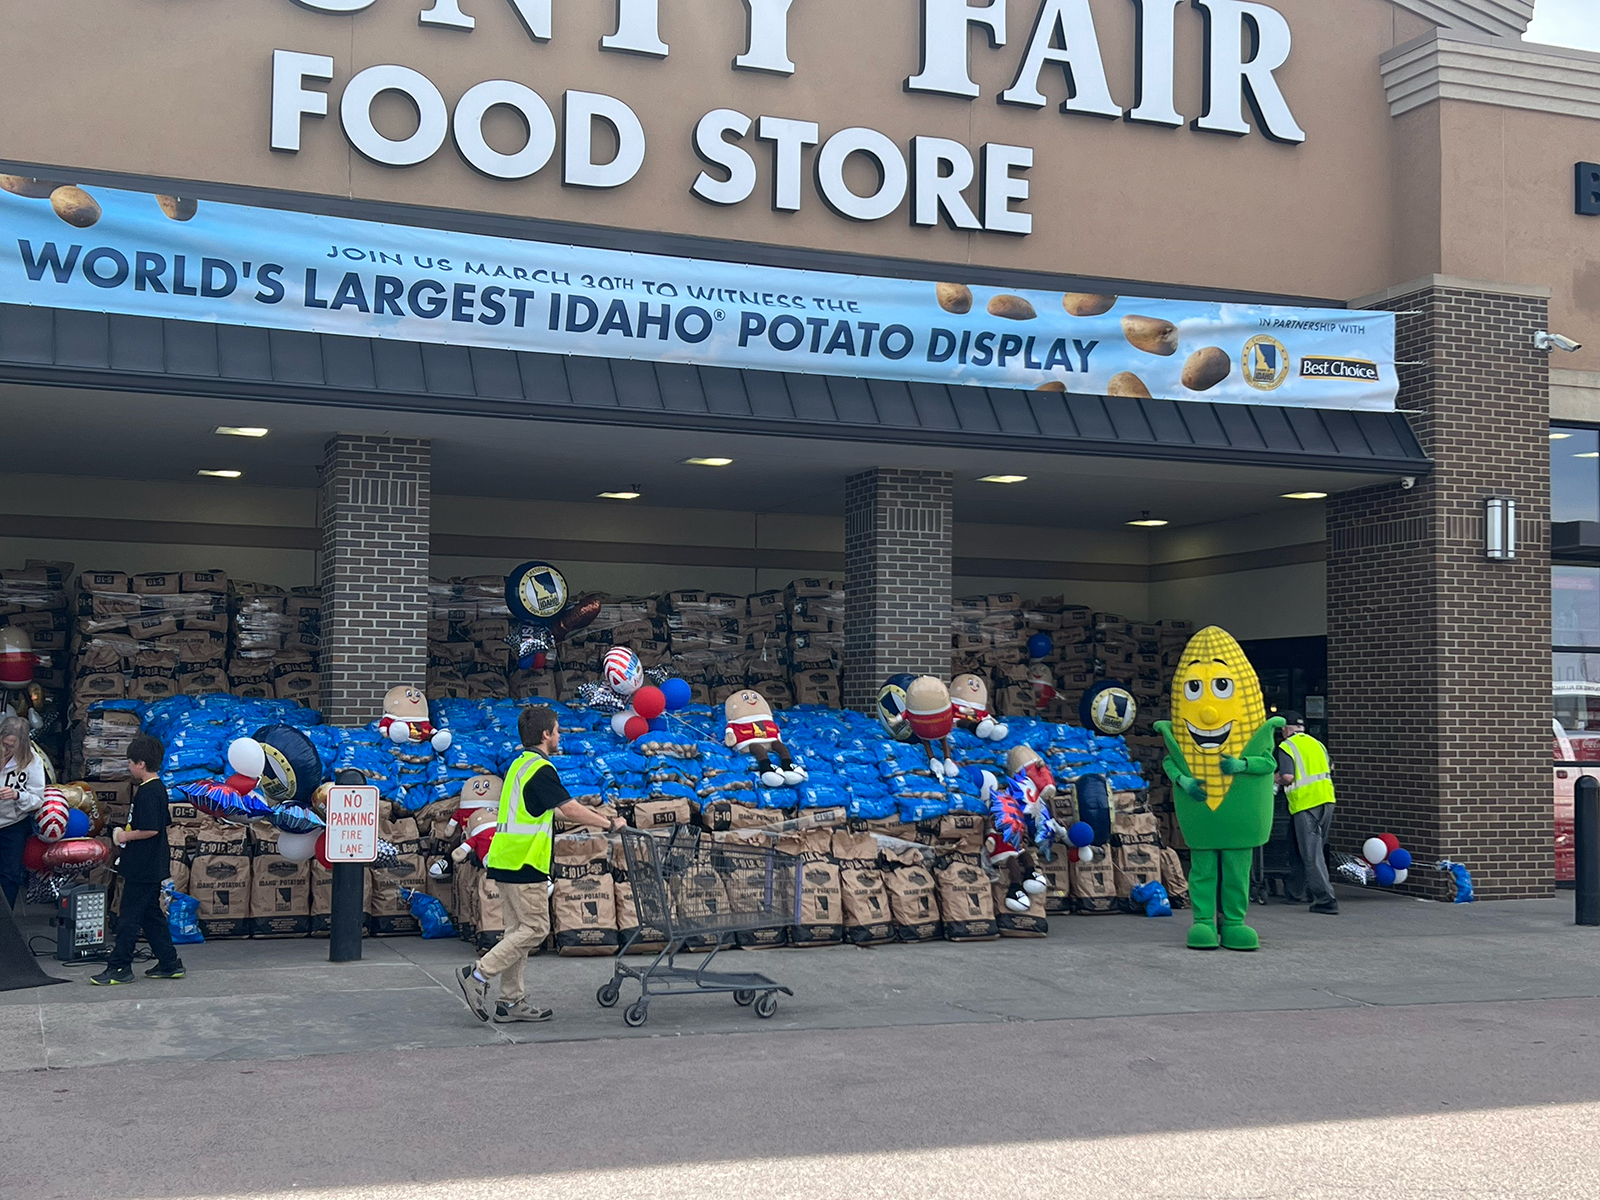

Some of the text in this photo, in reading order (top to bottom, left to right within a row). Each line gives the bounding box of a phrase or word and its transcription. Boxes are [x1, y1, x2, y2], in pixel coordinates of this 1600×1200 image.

[904, 0, 1305, 144] FAIR
[270, 48, 1034, 236] FOOD STORE
[326, 245, 862, 314] JOIN US MARCH 30TH TO WITNESS THE
[17, 238, 286, 305] WORLD'S
[303, 267, 535, 328] LARGEST
[737, 310, 914, 361] POTATO
[926, 327, 1099, 374] DISPLAY
[1259, 318, 1366, 335] IN PARTNERSHIP WITH
[1303, 360, 1330, 375] Best
[98, 792, 115, 800] 5-10
[343, 794, 363, 809] NO
[175, 807, 195, 817] 5-10
[655, 812, 674, 822] 5-10
[714, 812, 731, 821] 5-10
[331, 812, 374, 826] PARKING
[955, 817, 973, 828] 5-10
[852, 821, 868, 831] 5-10
[341, 830, 362, 840] FIRE
[200, 842, 217, 853] 5-10
[340, 844, 363, 854] LANE
[61, 859, 93, 870] IDAHO
[562, 866, 576, 878] 5-10
[217, 881, 246, 889] POTATOES
[280, 878, 306, 886] POTATOES
